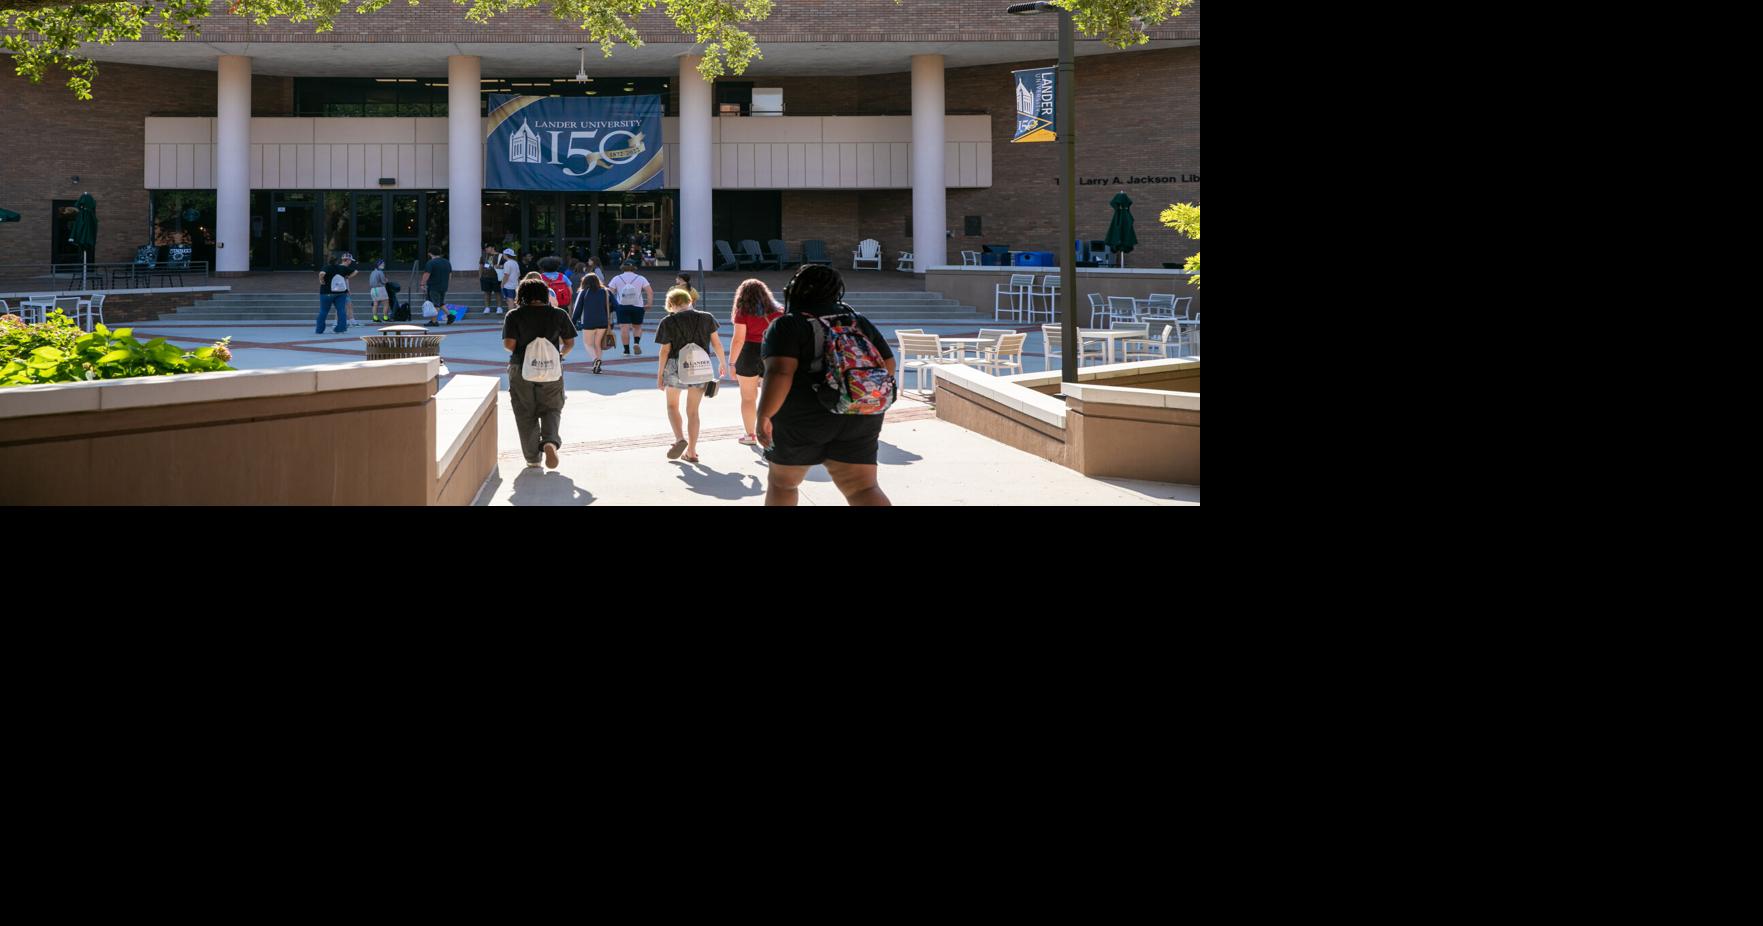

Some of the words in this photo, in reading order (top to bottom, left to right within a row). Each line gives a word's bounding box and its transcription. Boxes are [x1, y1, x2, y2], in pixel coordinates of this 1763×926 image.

[1041, 72, 1054, 115] LANDER
[535, 121, 577, 129] LANDER
[580, 120, 642, 129] UNIVERSITY
[1079, 177, 1109, 185] Larry
[1112, 176, 1123, 184] A.
[1127, 175, 1177, 184] Jackson
